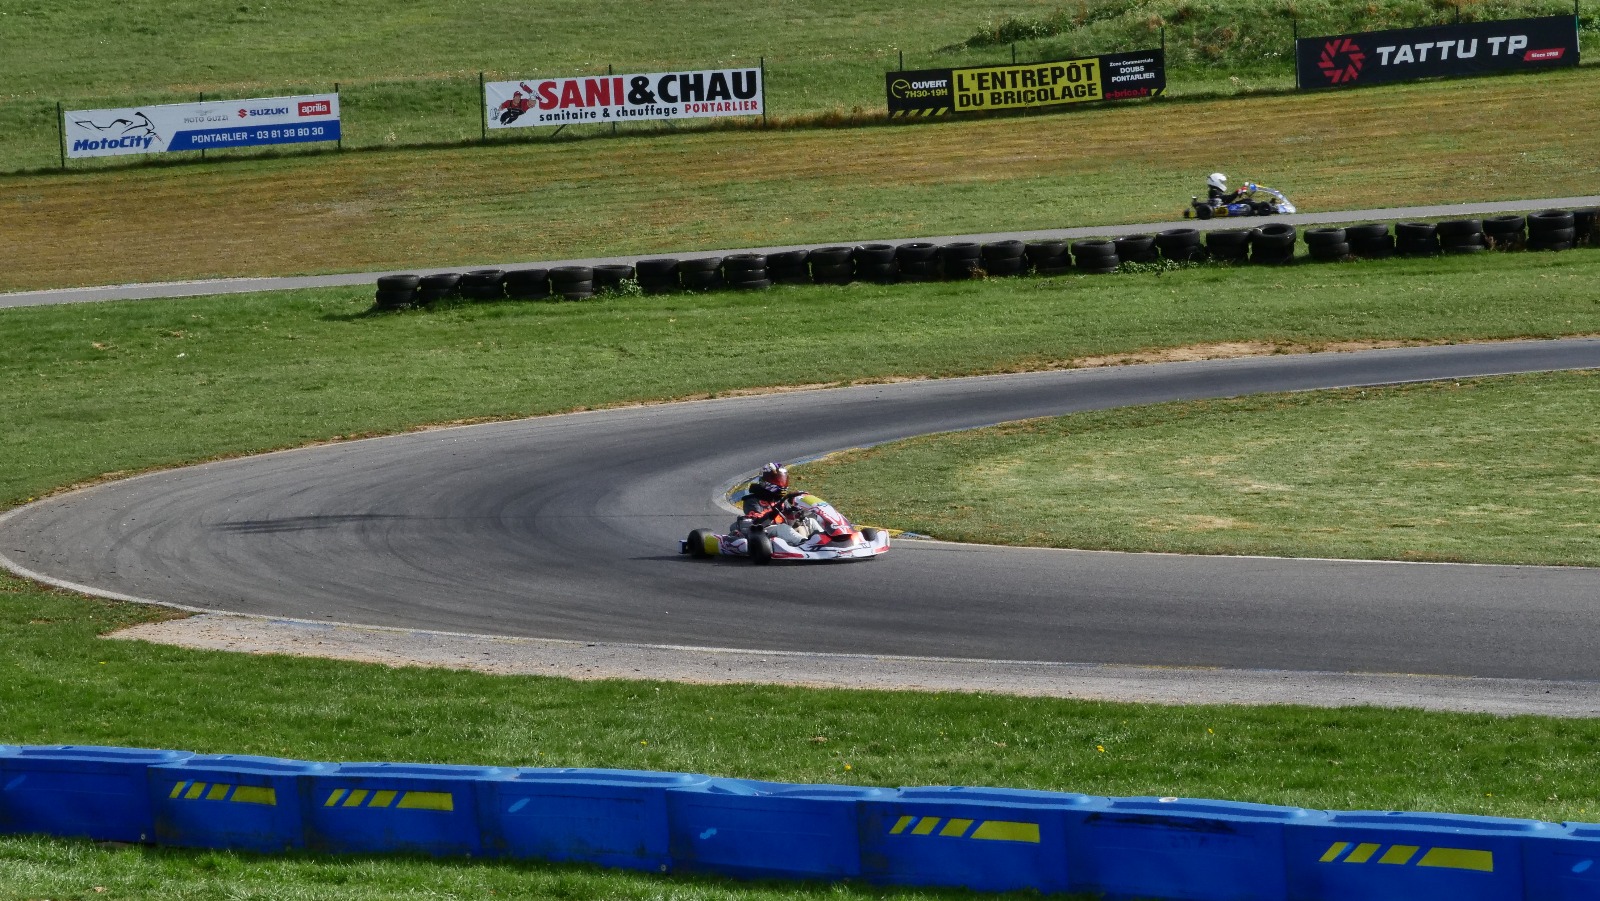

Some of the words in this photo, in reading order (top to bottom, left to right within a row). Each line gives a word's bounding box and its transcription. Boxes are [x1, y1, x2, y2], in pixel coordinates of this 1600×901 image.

[1376, 38, 1478, 66] TATTU
[1487, 34, 1528, 55] TP
[1120, 65, 1145, 74] DOUBS
[957, 62, 1096, 92] L'ENTREPÔT
[1111, 72, 1156, 83] PONTARLIER
[537, 70, 757, 111] SANI&CHAU
[911, 80, 948, 90] OUVERT
[904, 88, 948, 98] 7H30-19H
[958, 92, 985, 107] DU
[990, 82, 1098, 106] BRICOLAGE
[1105, 87, 1148, 99] e-brico.fr
[249, 107, 289, 117] SUZUKI
[301, 102, 328, 114] aprilia
[539, 109, 597, 122] sanitaire
[602, 107, 611, 118] &
[616, 105, 678, 117] chauffage
[684, 100, 758, 114] PONTARLIER
[184, 115, 205, 124] MOTO
[206, 114, 229, 122] GUZZI
[191, 131, 248, 143] PONTARLIER
[256, 130, 269, 140] 03
[271, 129, 281, 139] 81
[311, 126, 324, 136] 30
[73, 135, 153, 152] MotoCity
